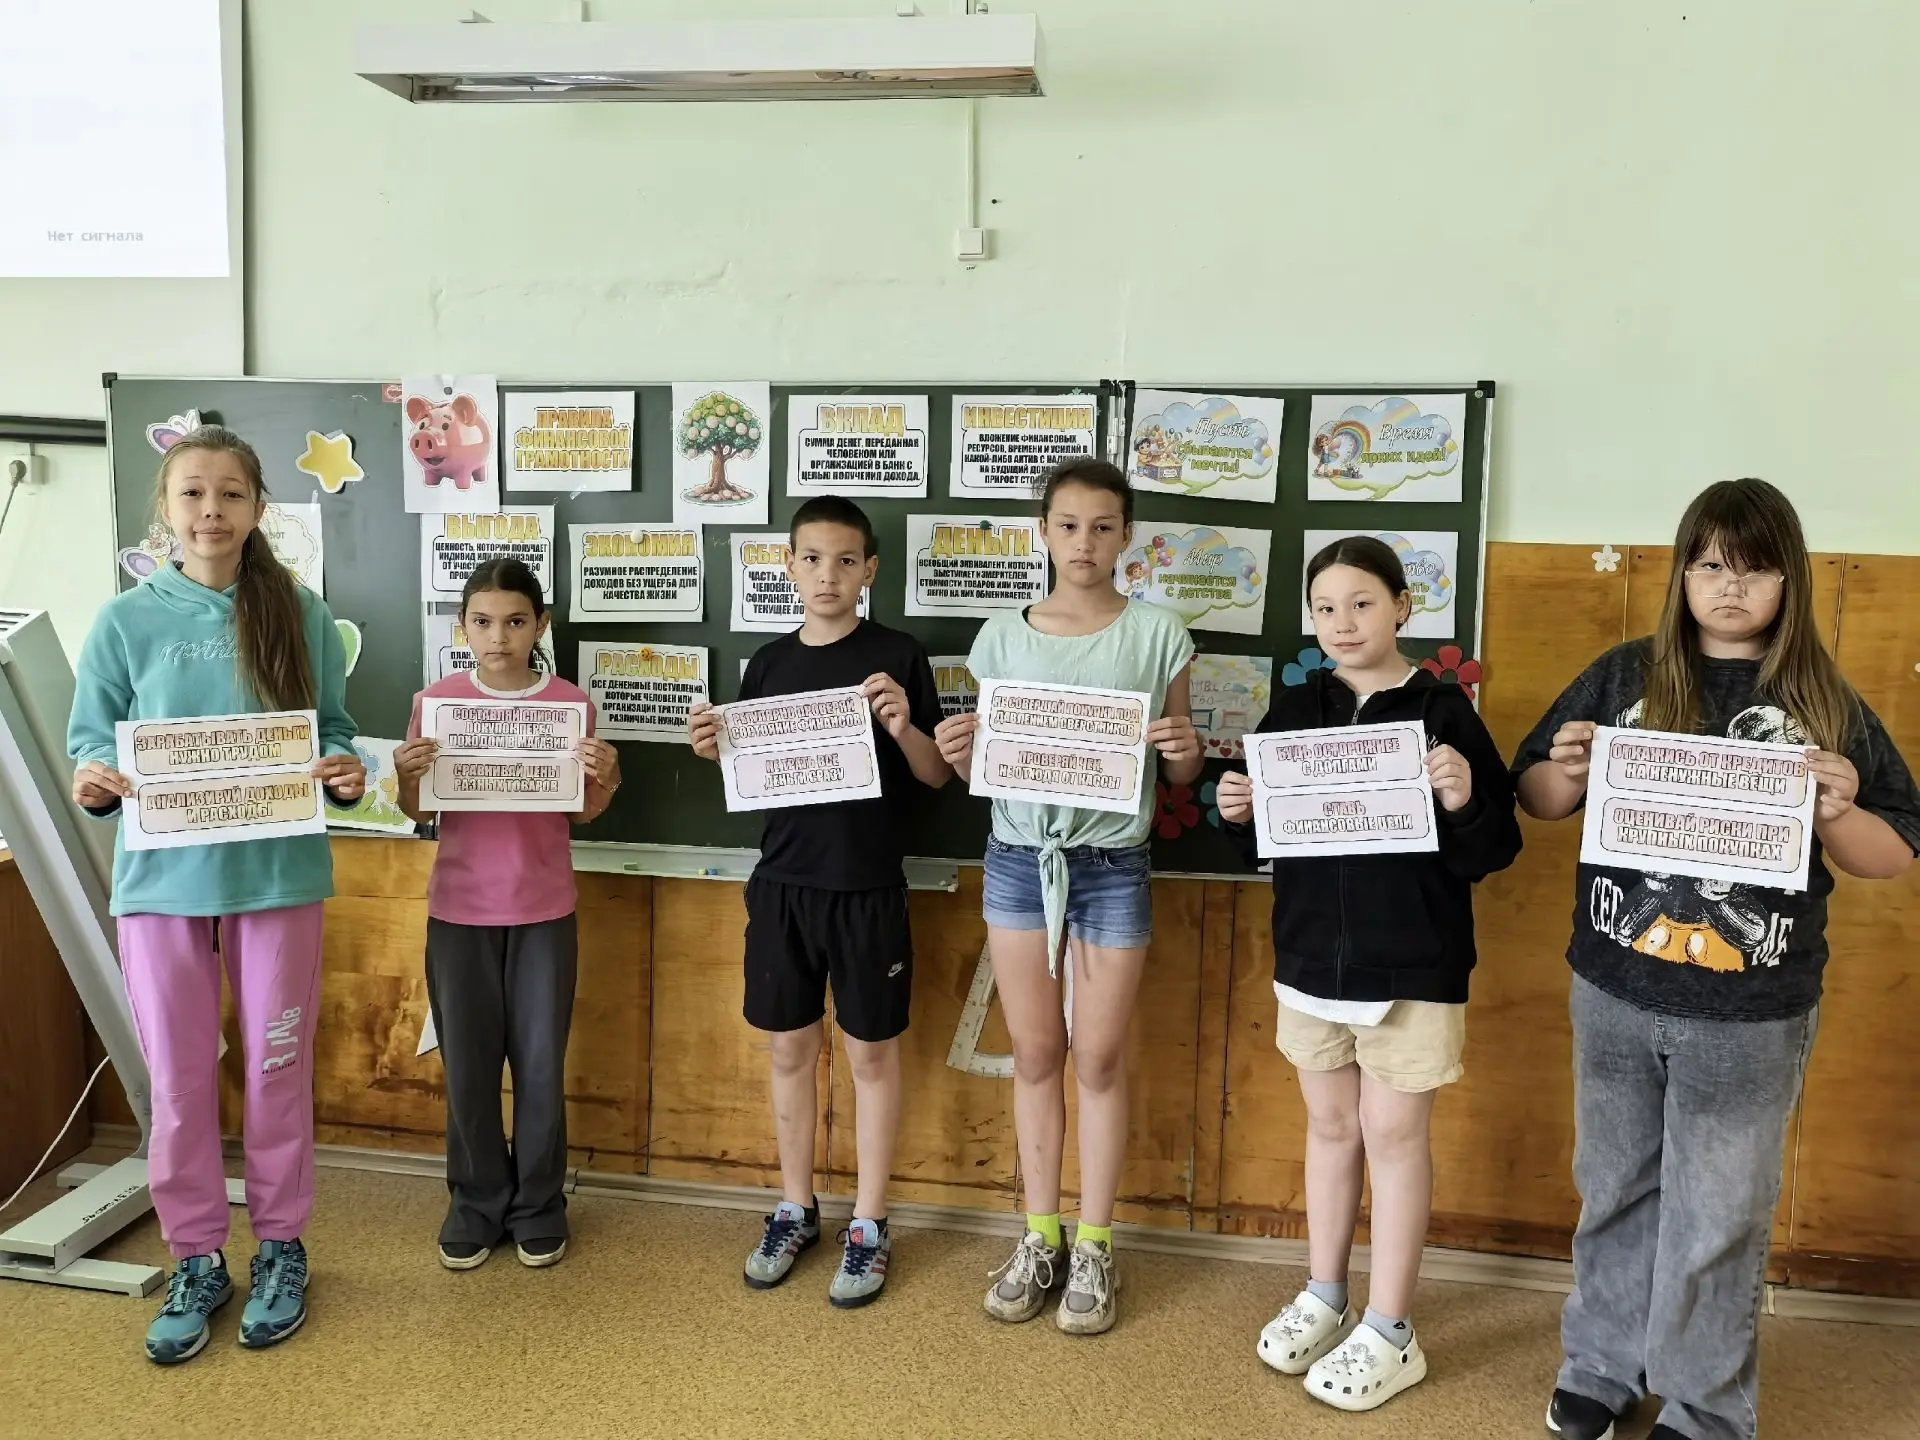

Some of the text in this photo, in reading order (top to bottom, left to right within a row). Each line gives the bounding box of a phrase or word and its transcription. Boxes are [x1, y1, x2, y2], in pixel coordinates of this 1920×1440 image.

[48, 231, 144, 241] Нет сигнала
[536, 409, 613, 428] ПРАВИЛА
[820, 406, 904, 437] ВКЛАД
[964, 407, 1091, 432] ИНВЕСТИЦИИ
[516, 424, 629, 449] ФИНАНСОВОЙ
[1195, 417, 1250, 443] Пусть
[1379, 424, 1434, 449] Время
[805, 437, 919, 449] СУММА ДЕНЕГ, ПЕРЕДАННАЯ
[979, 434, 1077, 443] ВЛОЖЕНИЕ ФИНАНСОВЫХ
[827, 449, 896, 459] ЧЕЛОВЕКОМ ИЛИ
[967, 444, 1007, 454] РЕСУРСОВ,
[1008, 445, 1042, 453] ВРЕМЕНИ
[1051, 444, 1081, 453] УСИЛИЙ
[1177, 440, 1253, 459] сбываются
[516, 449, 630, 470] ГРАМОТНОСТИ
[811, 459, 913, 471] ОРГАНИЗАЦИЕЙ В БАНК С
[965, 454, 1013, 463] КАКОЙ-ЛИБО
[1014, 455, 1039, 463] АКТИВ
[1361, 447, 1447, 468] ярких идей!
[980, 465, 989, 473] НА
[991, 464, 1029, 474] БУДУЩИЙ
[1191, 459, 1239, 474] мечты!
[802, 471, 831, 481] ЦЕЛЬЮ
[833, 471, 881, 480] ПОЛУЧЕНИЯ
[985, 475, 1019, 484] ПРИРОСТ
[447, 515, 540, 543] ВЫГОДА
[436, 543, 547, 552] ЦЕННОСТЬ, КОТОРУЮ ПОЛУЧАЕТ
[585, 534, 695, 557] ЭКОНОМИЯ
[931, 526, 1029, 558] ДЕНЬГИ
[440, 553, 476, 562] ИНДИВИД
[478, 553, 492, 561] ИЛИ
[919, 559, 1042, 570] ВСЕОБЩИЙ ЭКВИВАЛЕНТ, КОТОРЫЙ
[1183, 548, 1224, 574] Мир
[443, 562, 451, 570] ОТ
[584, 567, 697, 577] РАЗУМНОЕ РАСПРЕДЕЛЕНИЕ
[749, 571, 777, 581] ЧАСТЬ
[934, 570, 1027, 579] ВЫСТУПАЕТ ИЗМЕРИТЕЛЕМ
[1158, 573, 1236, 587] начинается
[584, 579, 697, 589] ДОХОДОВ БЕЗ УЩЕРБА ДЛЯ
[753, 583, 791, 592] ЧЕЛОВЕК
[920, 579, 962, 587] СТОИМОСТИ
[964, 580, 996, 589] ТОВАРОВ
[997, 581, 1011, 589] ИЛИ
[1013, 581, 1034, 590] УСЛУГ
[603, 590, 677, 599] КАЧЕСТВА ЖИЗНИ
[746, 593, 796, 604] СОХРАНЯЕТ,
[927, 589, 948, 598] ЛЕГКО
[950, 590, 959, 598] НА
[961, 590, 974, 598] НИХ
[1178, 588, 1232, 600] детства
[754, 605, 791, 615] ТЕКУЩЕЕ
[600, 652, 697, 681] РАСХОДЫ
[592, 680, 704, 694] ВСЕ ДЕНЕЖНЫЕ ПОСТУПЛЕНИЯ,
[605, 691, 692, 704] КОТОРЫЕ ЧЕЛОВЕК ИЛИ
[453, 707, 567, 723] СОСТАВЛЯЙ СПИСОК
[602, 703, 656, 713] ОРГАНИЗАЦИЯ
[658, 705, 684, 714] ТРАТЯТ
[798, 698, 855, 718] ПРОВЕРЯЙ
[994, 696, 1007, 708] НЕ
[1008, 697, 1064, 714] СОВЕРШАЙ
[1066, 702, 1115, 719] ПОКУПКИ
[1116, 708, 1141, 723] ПОД
[609, 714, 656, 724] РАЗЛИЧНЫЕ
[731, 714, 862, 739] СОСТОЯНИЕ ФИНАНСОВ
[994, 710, 1134, 737] ДАВЛЕНИЕМ СВЕРСТНИКОВ
[465, 721, 554, 736] ПОКУПОК ПЕРЕД
[137, 725, 309, 751] ЗАРАБАТЫВАТЬ ДЕНЬГИ
[449, 734, 568, 749] ПОХОДОМ В МАГАЗИН
[169, 743, 281, 765] НУЖНО ТРУДОМ
[1276, 738, 1400, 761] БУДЬ ОСТОРОЖНЕЕ
[766, 753, 839, 773] НЕ ТРАТЬ ВСЕ
[1018, 751, 1078, 769] ПРОВЕРЯЙ
[1302, 757, 1378, 777] С ДОЛГАМИ
[1612, 743, 1806, 777] ОТКАЖИСЬ ОТ КРЕДИТОВ
[453, 764, 560, 779] СРАВНИВАЙ ЦЕНЫ
[764, 767, 844, 790] ДЕНЬГИ СРАЗУ
[999, 764, 1121, 790] НЕ ОТХОДЯ ОТ КАССЫ
[454, 778, 558, 792] РАЗНЫХ ТОВАРОВ
[1626, 763, 1787, 796] НА НЕНУЖНЫЕ ВЕЩИ
[147, 783, 309, 810] АНАЛИЗИРУЙ ДОХОДЫ
[187, 802, 272, 823] И РАСХОДЫ
[1323, 800, 1366, 816] СТАВЬ
[1283, 814, 1413, 835] ФИНАНСОВЫЕ ЦЕЛИ
[1613, 808, 1790, 844] ОЦЕНИВАЙ РИСКИ ПРИ
[1617, 827, 1782, 861] КРУПНЫХ ПОКУПКАХ
